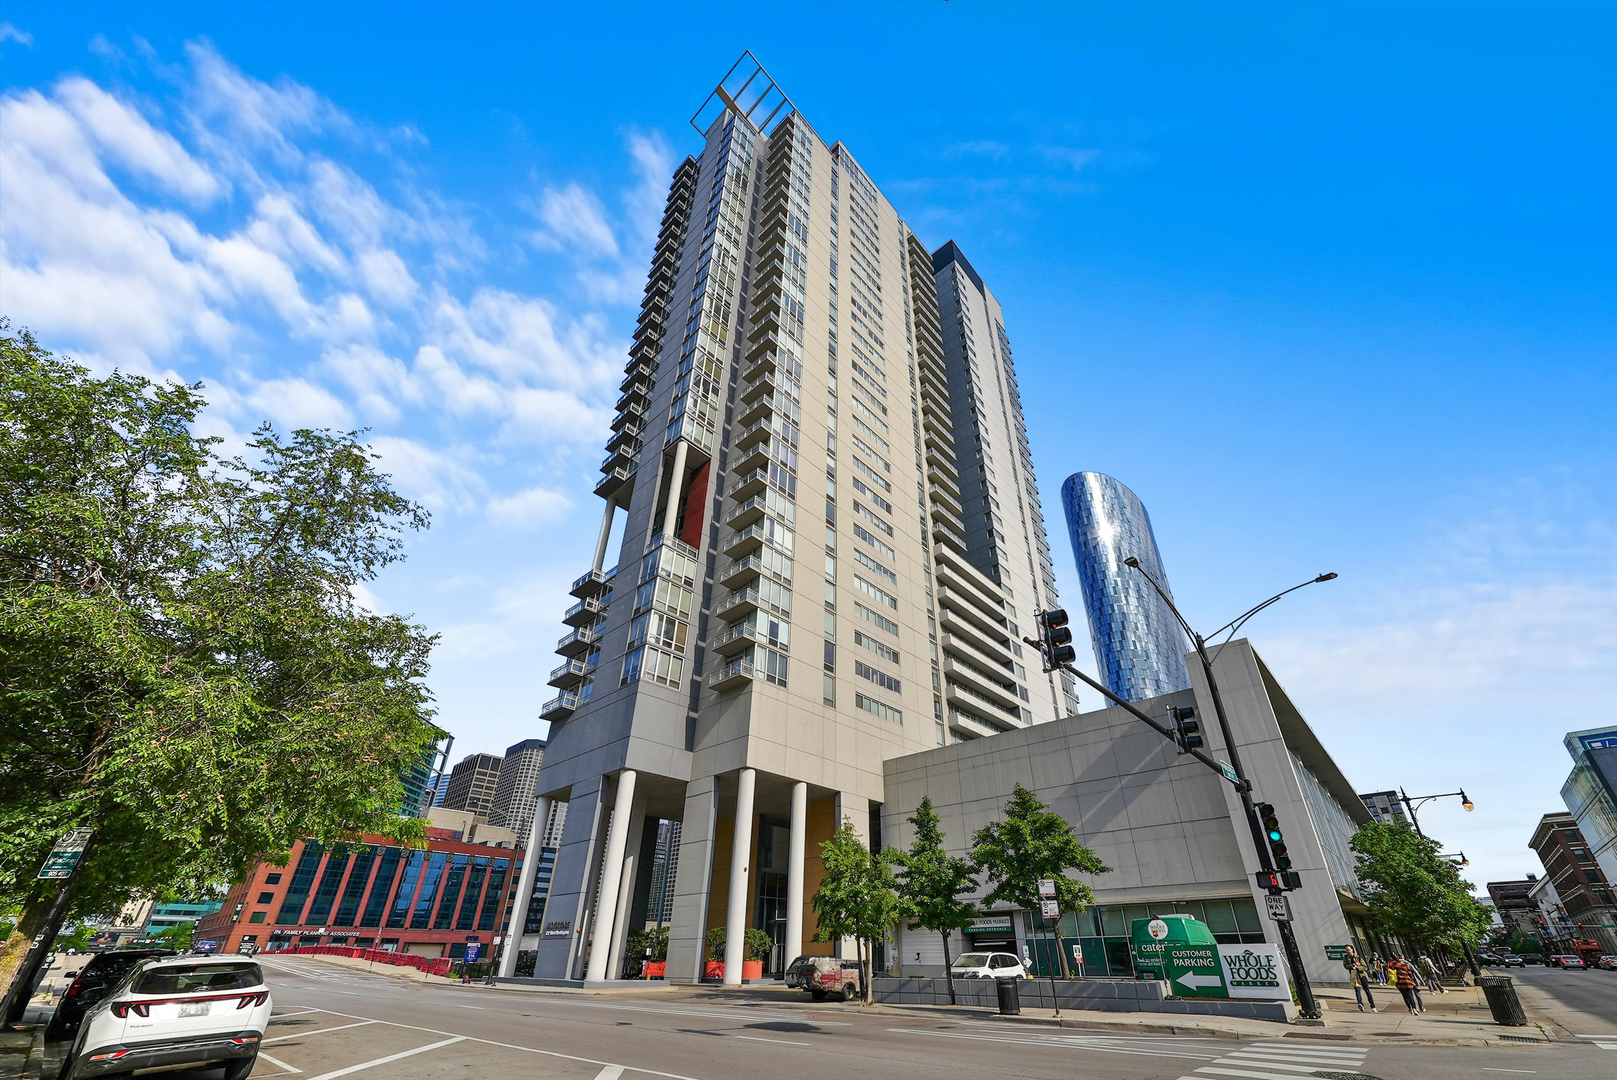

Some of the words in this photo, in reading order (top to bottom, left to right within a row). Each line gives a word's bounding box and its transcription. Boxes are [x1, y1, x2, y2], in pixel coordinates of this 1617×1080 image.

[1270, 874, 1278, 885] 6
[1173, 958, 1215, 967] PARKING
[1223, 954, 1277, 968] WHOLE
[1229, 967, 1277, 980] FOODS
